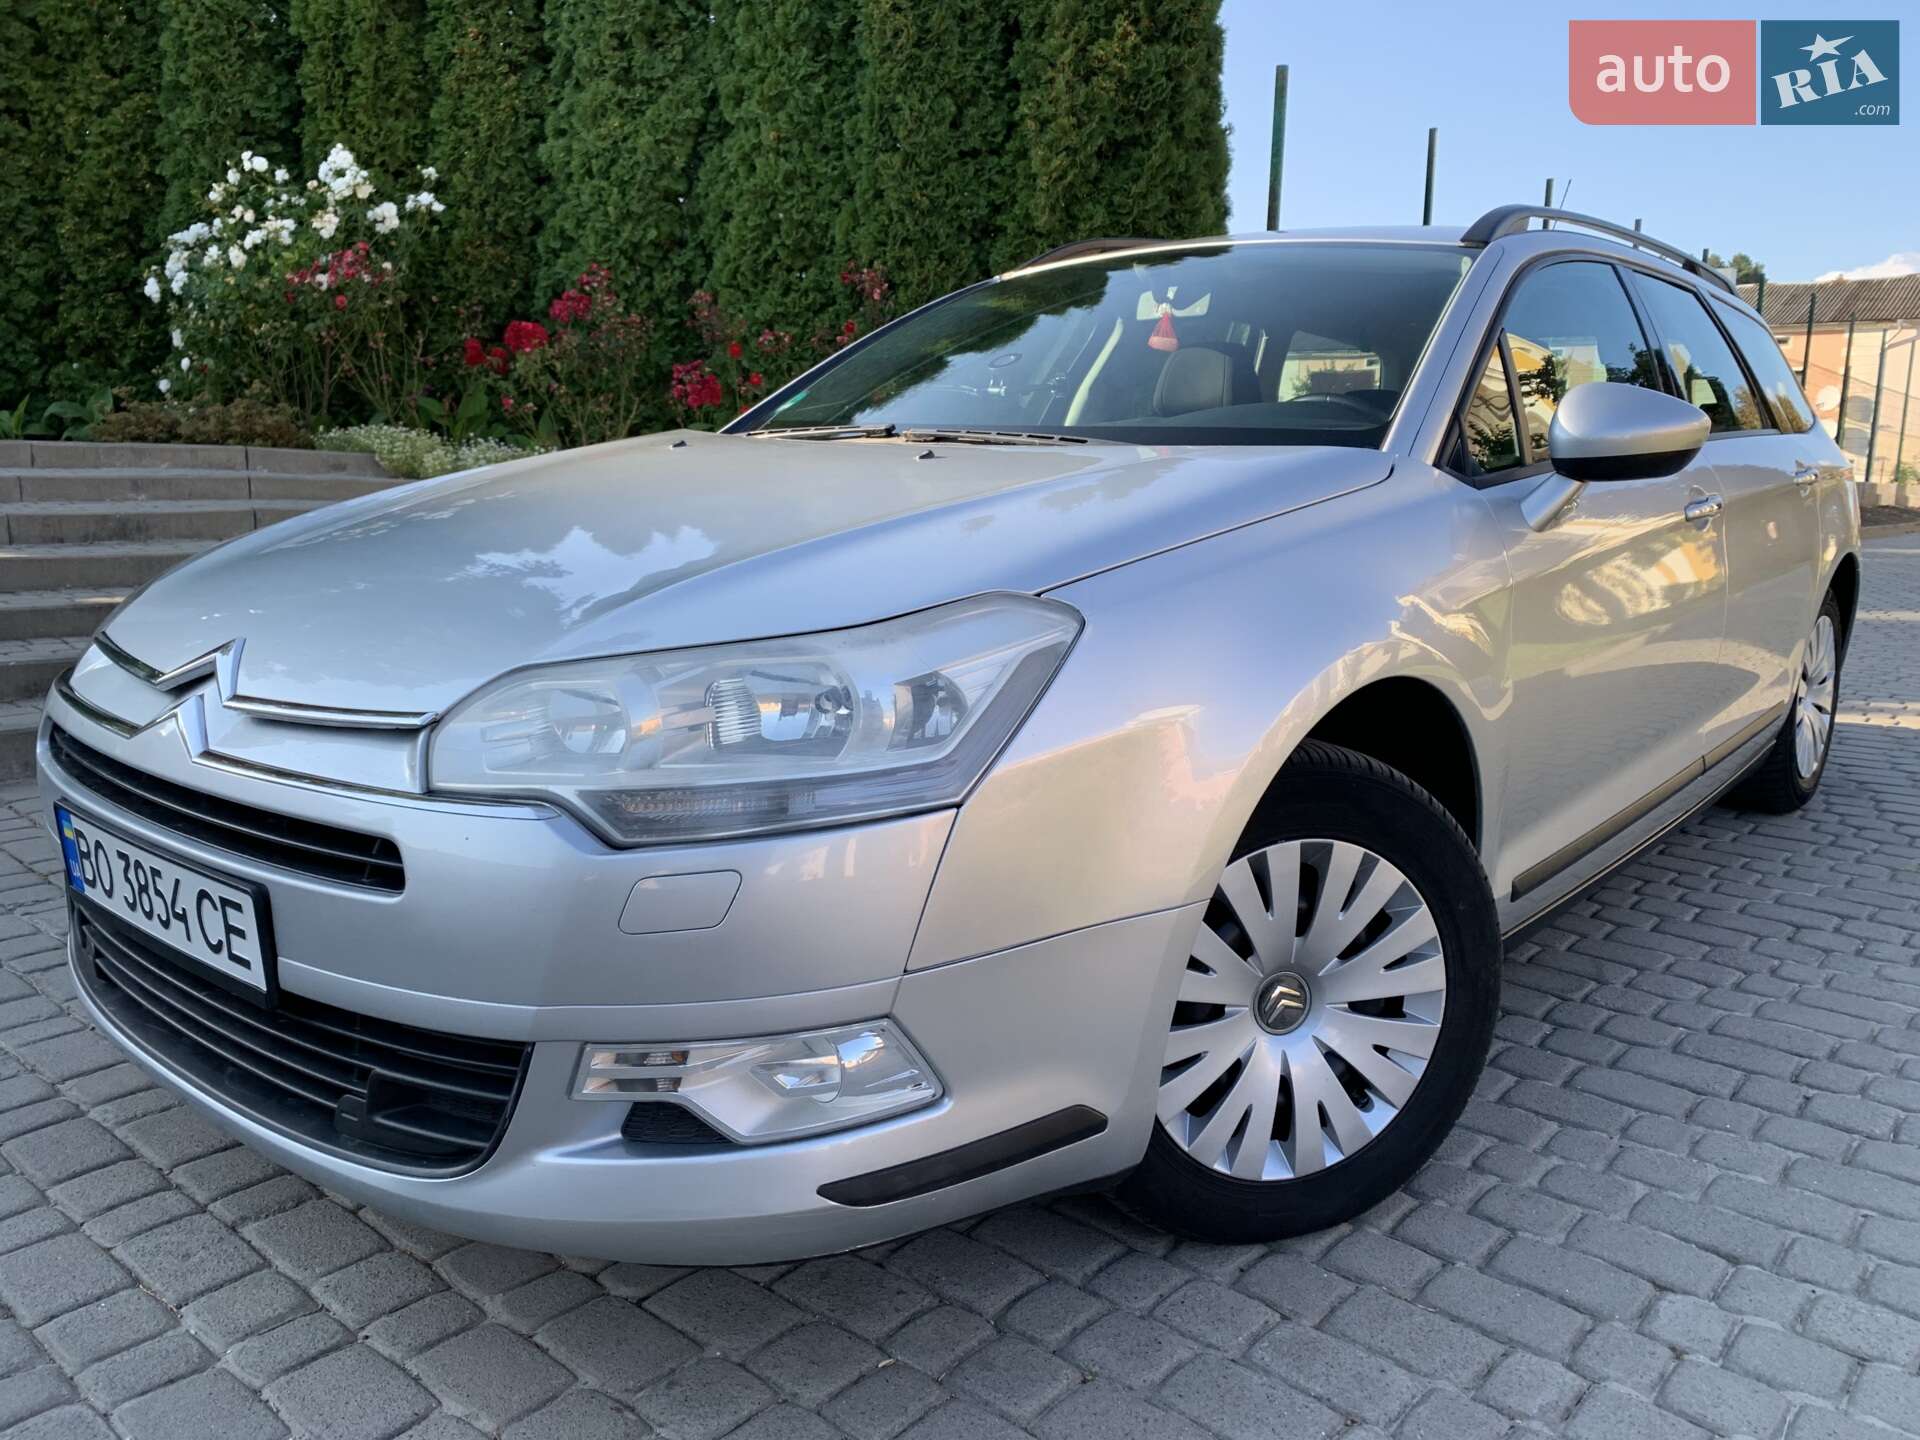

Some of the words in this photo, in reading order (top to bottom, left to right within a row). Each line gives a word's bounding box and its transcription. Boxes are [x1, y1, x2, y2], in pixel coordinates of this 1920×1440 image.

[74, 827, 113, 899] BO
[116, 849, 191, 942] 3854
[196, 888, 251, 970] CE
